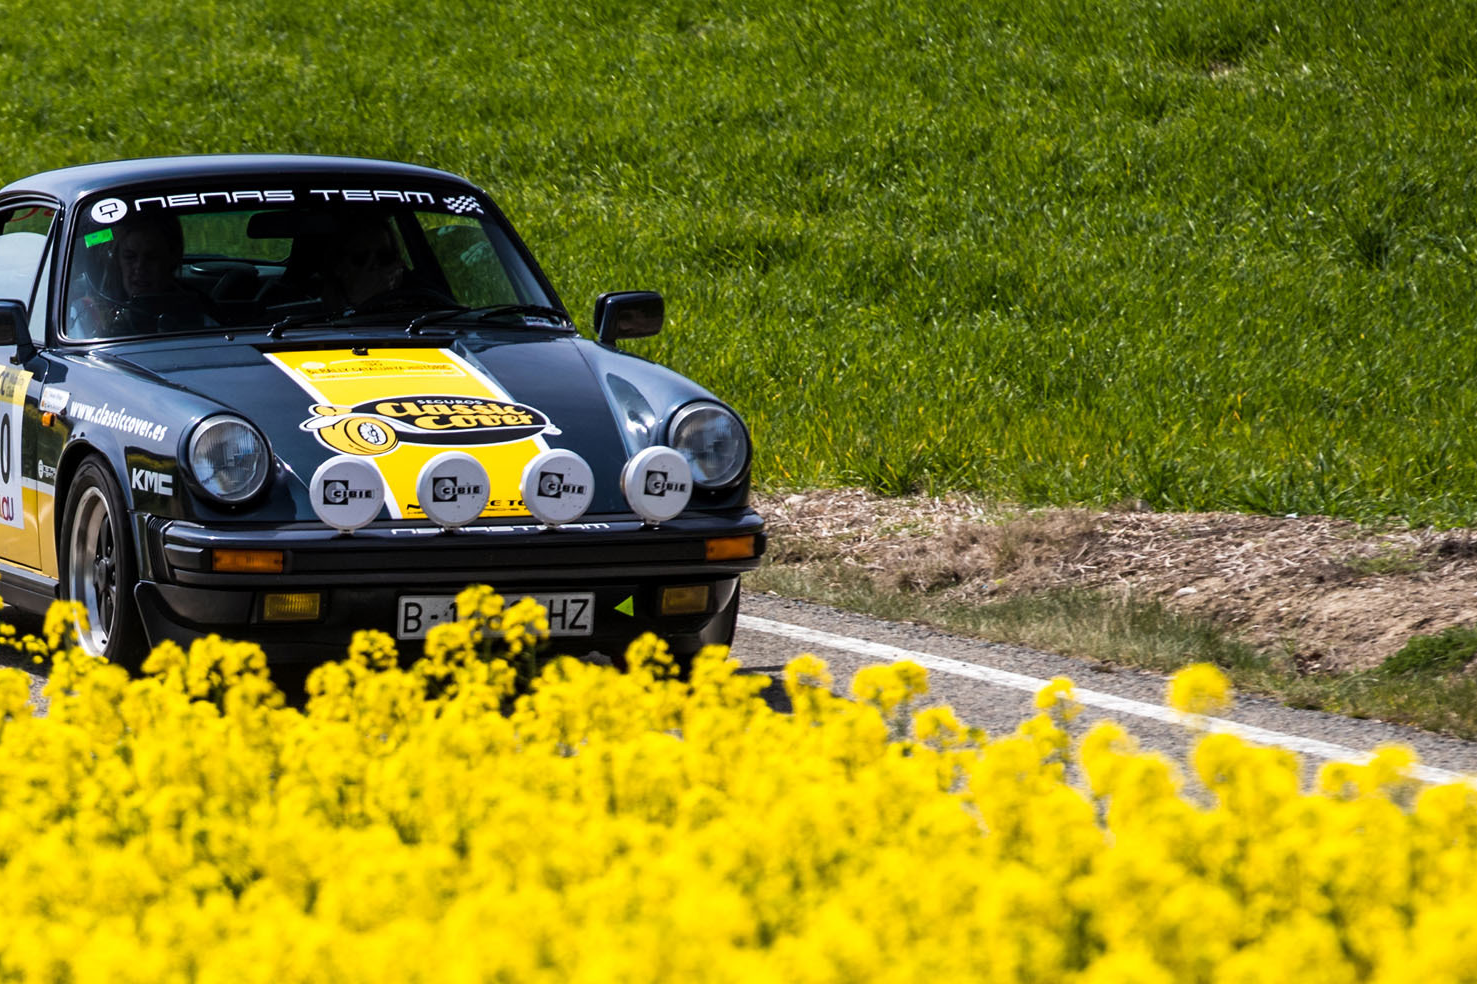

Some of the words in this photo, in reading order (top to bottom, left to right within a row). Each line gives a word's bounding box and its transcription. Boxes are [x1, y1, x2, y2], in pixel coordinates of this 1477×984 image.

[134, 190, 295, 211] NENAS
[310, 189, 435, 204] TEAM
[70, 401, 168, 442] www.classiccover.es
[375, 402, 526, 418] Classic
[131, 467, 173, 496] KMC
